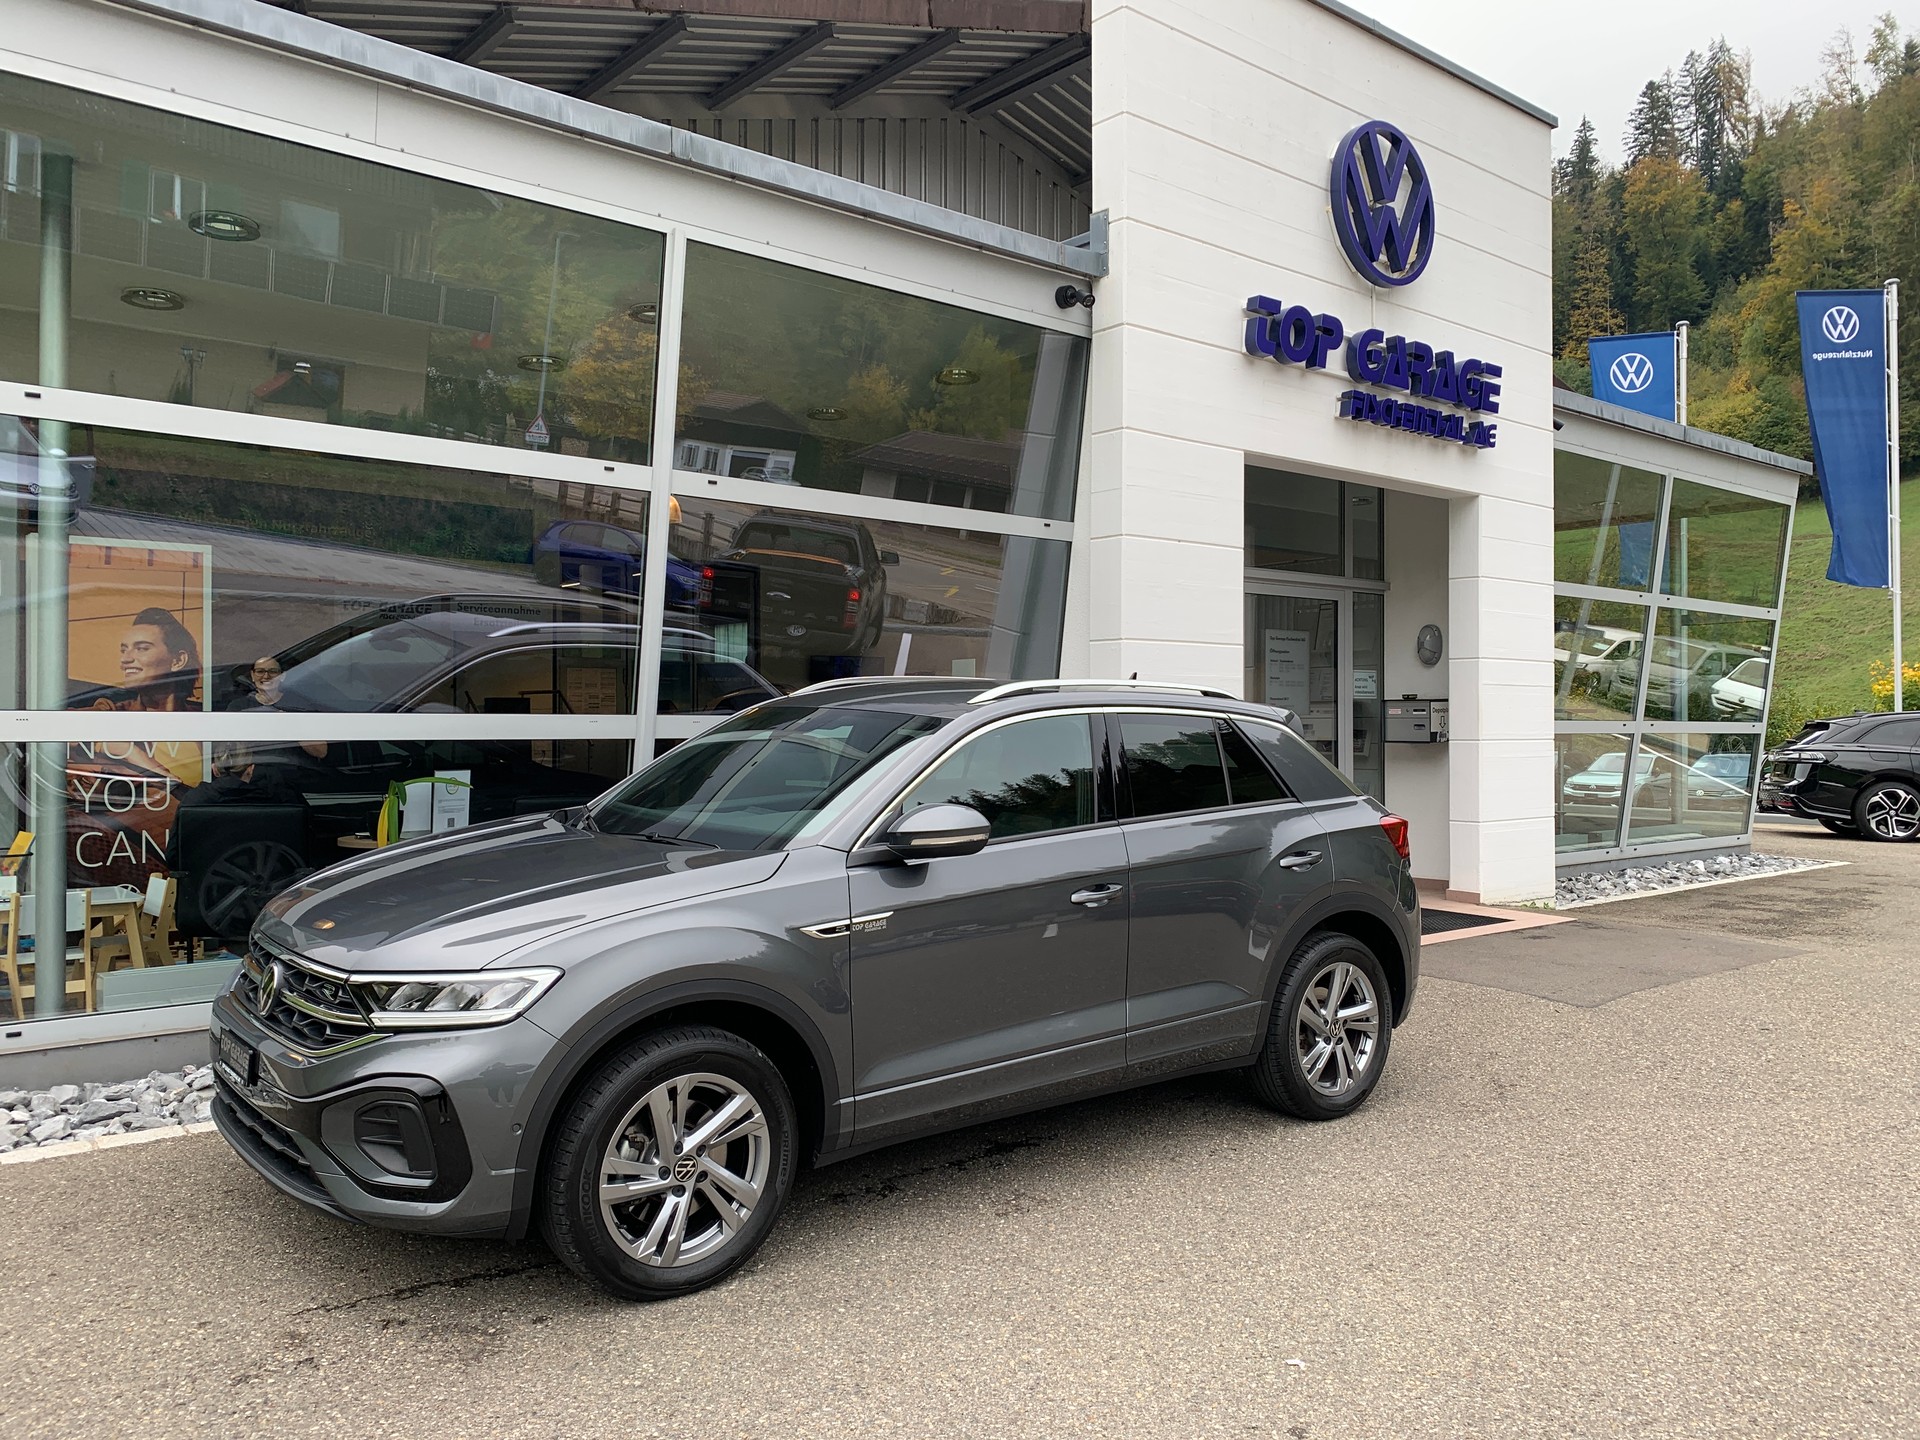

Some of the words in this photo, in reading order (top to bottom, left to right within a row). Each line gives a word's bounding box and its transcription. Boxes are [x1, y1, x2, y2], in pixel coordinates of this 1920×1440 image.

[1245, 294, 1344, 370] TOP
[1347, 327, 1503, 414] GARAGE
[457, 602, 541, 616] Serviceannahme
[73, 776, 171, 813] YOU
[76, 829, 170, 868] CAN
